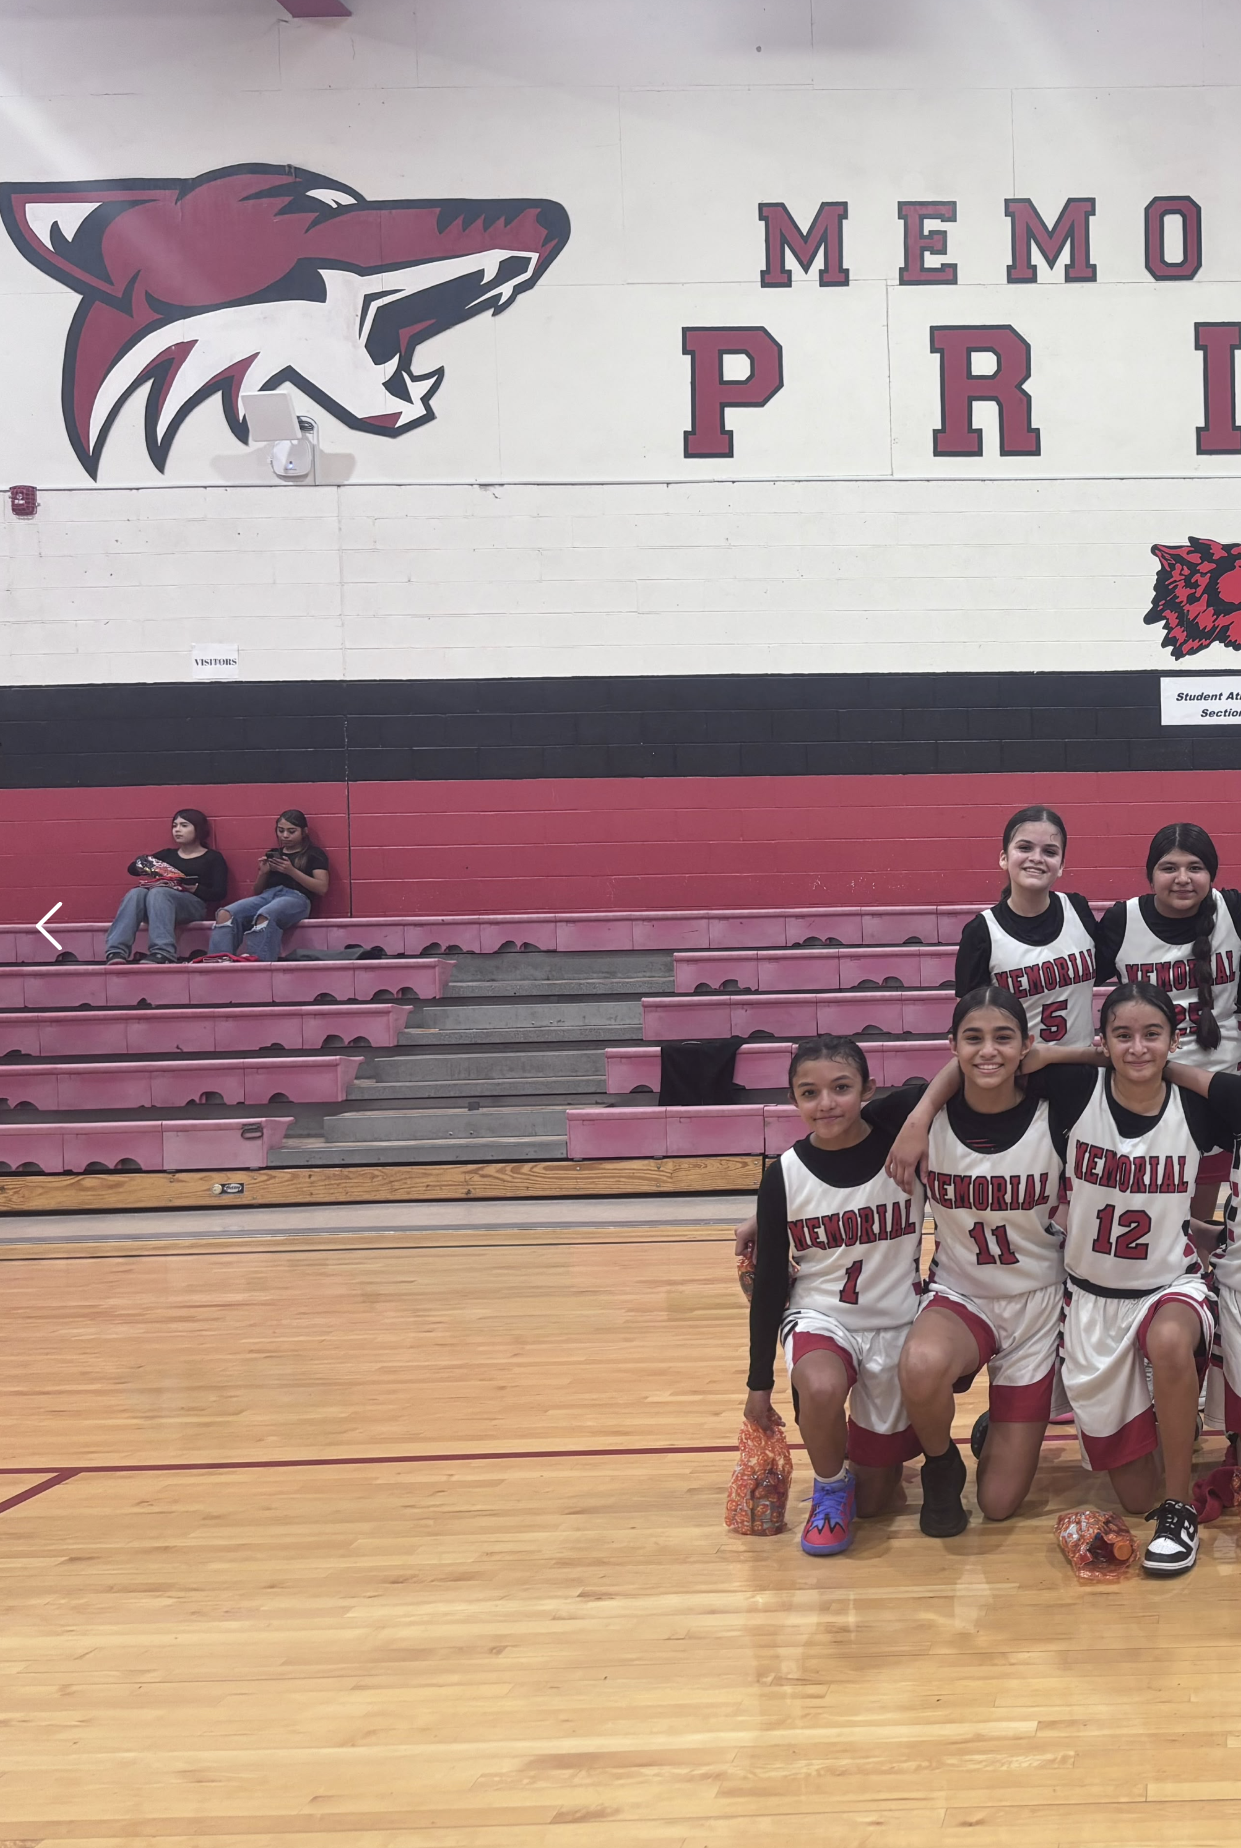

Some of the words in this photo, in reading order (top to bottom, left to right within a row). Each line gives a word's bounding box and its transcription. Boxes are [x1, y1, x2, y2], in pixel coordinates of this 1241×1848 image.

[194, 658, 237, 667] VISITORS
[1175, 692, 1223, 702] Student
[994, 949, 1096, 1000] MEMORIAL
[1125, 950, 1236, 993] MEMORAL
[1040, 999, 1068, 1042] 5
[1074, 1140, 1188, 1194] MEMORIAL
[787, 1198, 916, 1252] MEMORIAL
[969, 1221, 1020, 1265] 11
[1092, 1203, 1152, 1260] 12
[839, 1259, 863, 1305] 1
